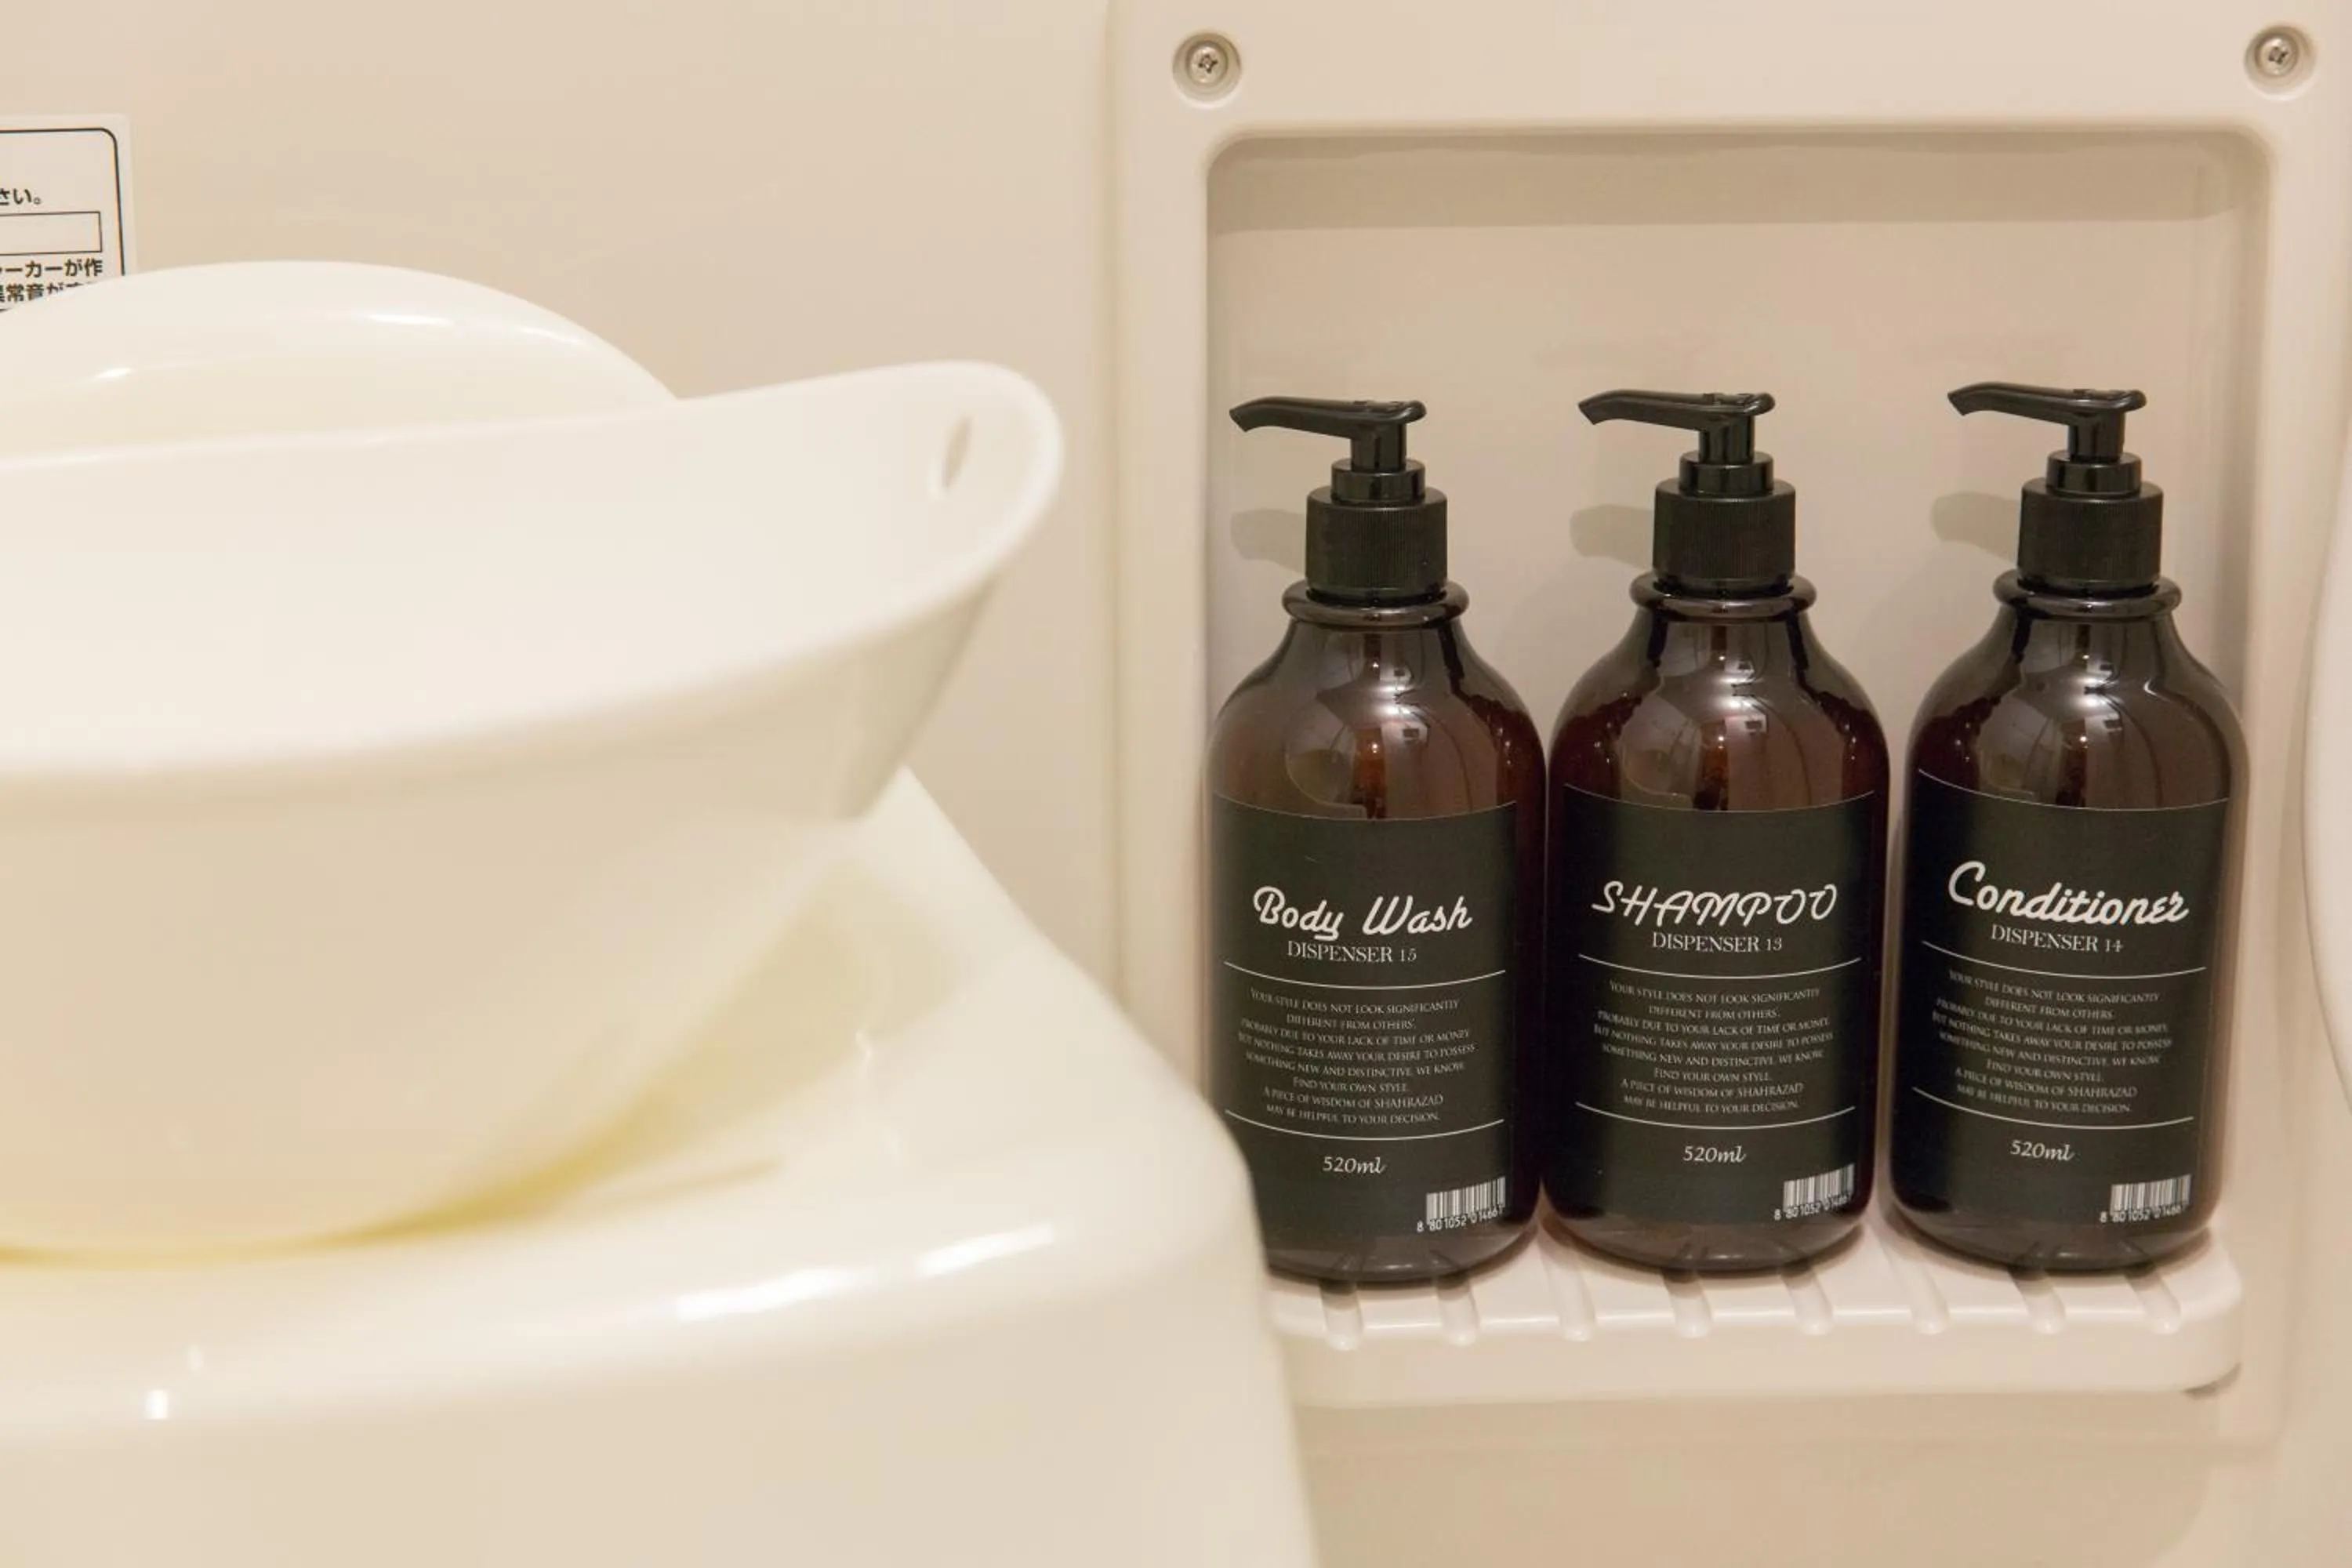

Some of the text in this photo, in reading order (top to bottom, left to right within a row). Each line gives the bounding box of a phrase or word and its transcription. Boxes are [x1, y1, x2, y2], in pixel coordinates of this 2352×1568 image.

[0, 258, 103, 278] ーカーが作
[1592, 880, 1838, 927] SHAMPOO
[1948, 861, 2190, 925] Conditioner
[1253, 886, 1472, 941] Body Wash
[1652, 931, 1782, 953] DISPENSER 13
[1991, 924, 2124, 953] DISPENSER 14
[1287, 940, 1417, 963] DISPENSER 15
[1682, 1145, 1747, 1163] 520ml
[2011, 1139, 2075, 1162] 520ml
[1323, 1156, 1385, 1174] 520ml
[1417, 1220, 1424, 1232] 8
